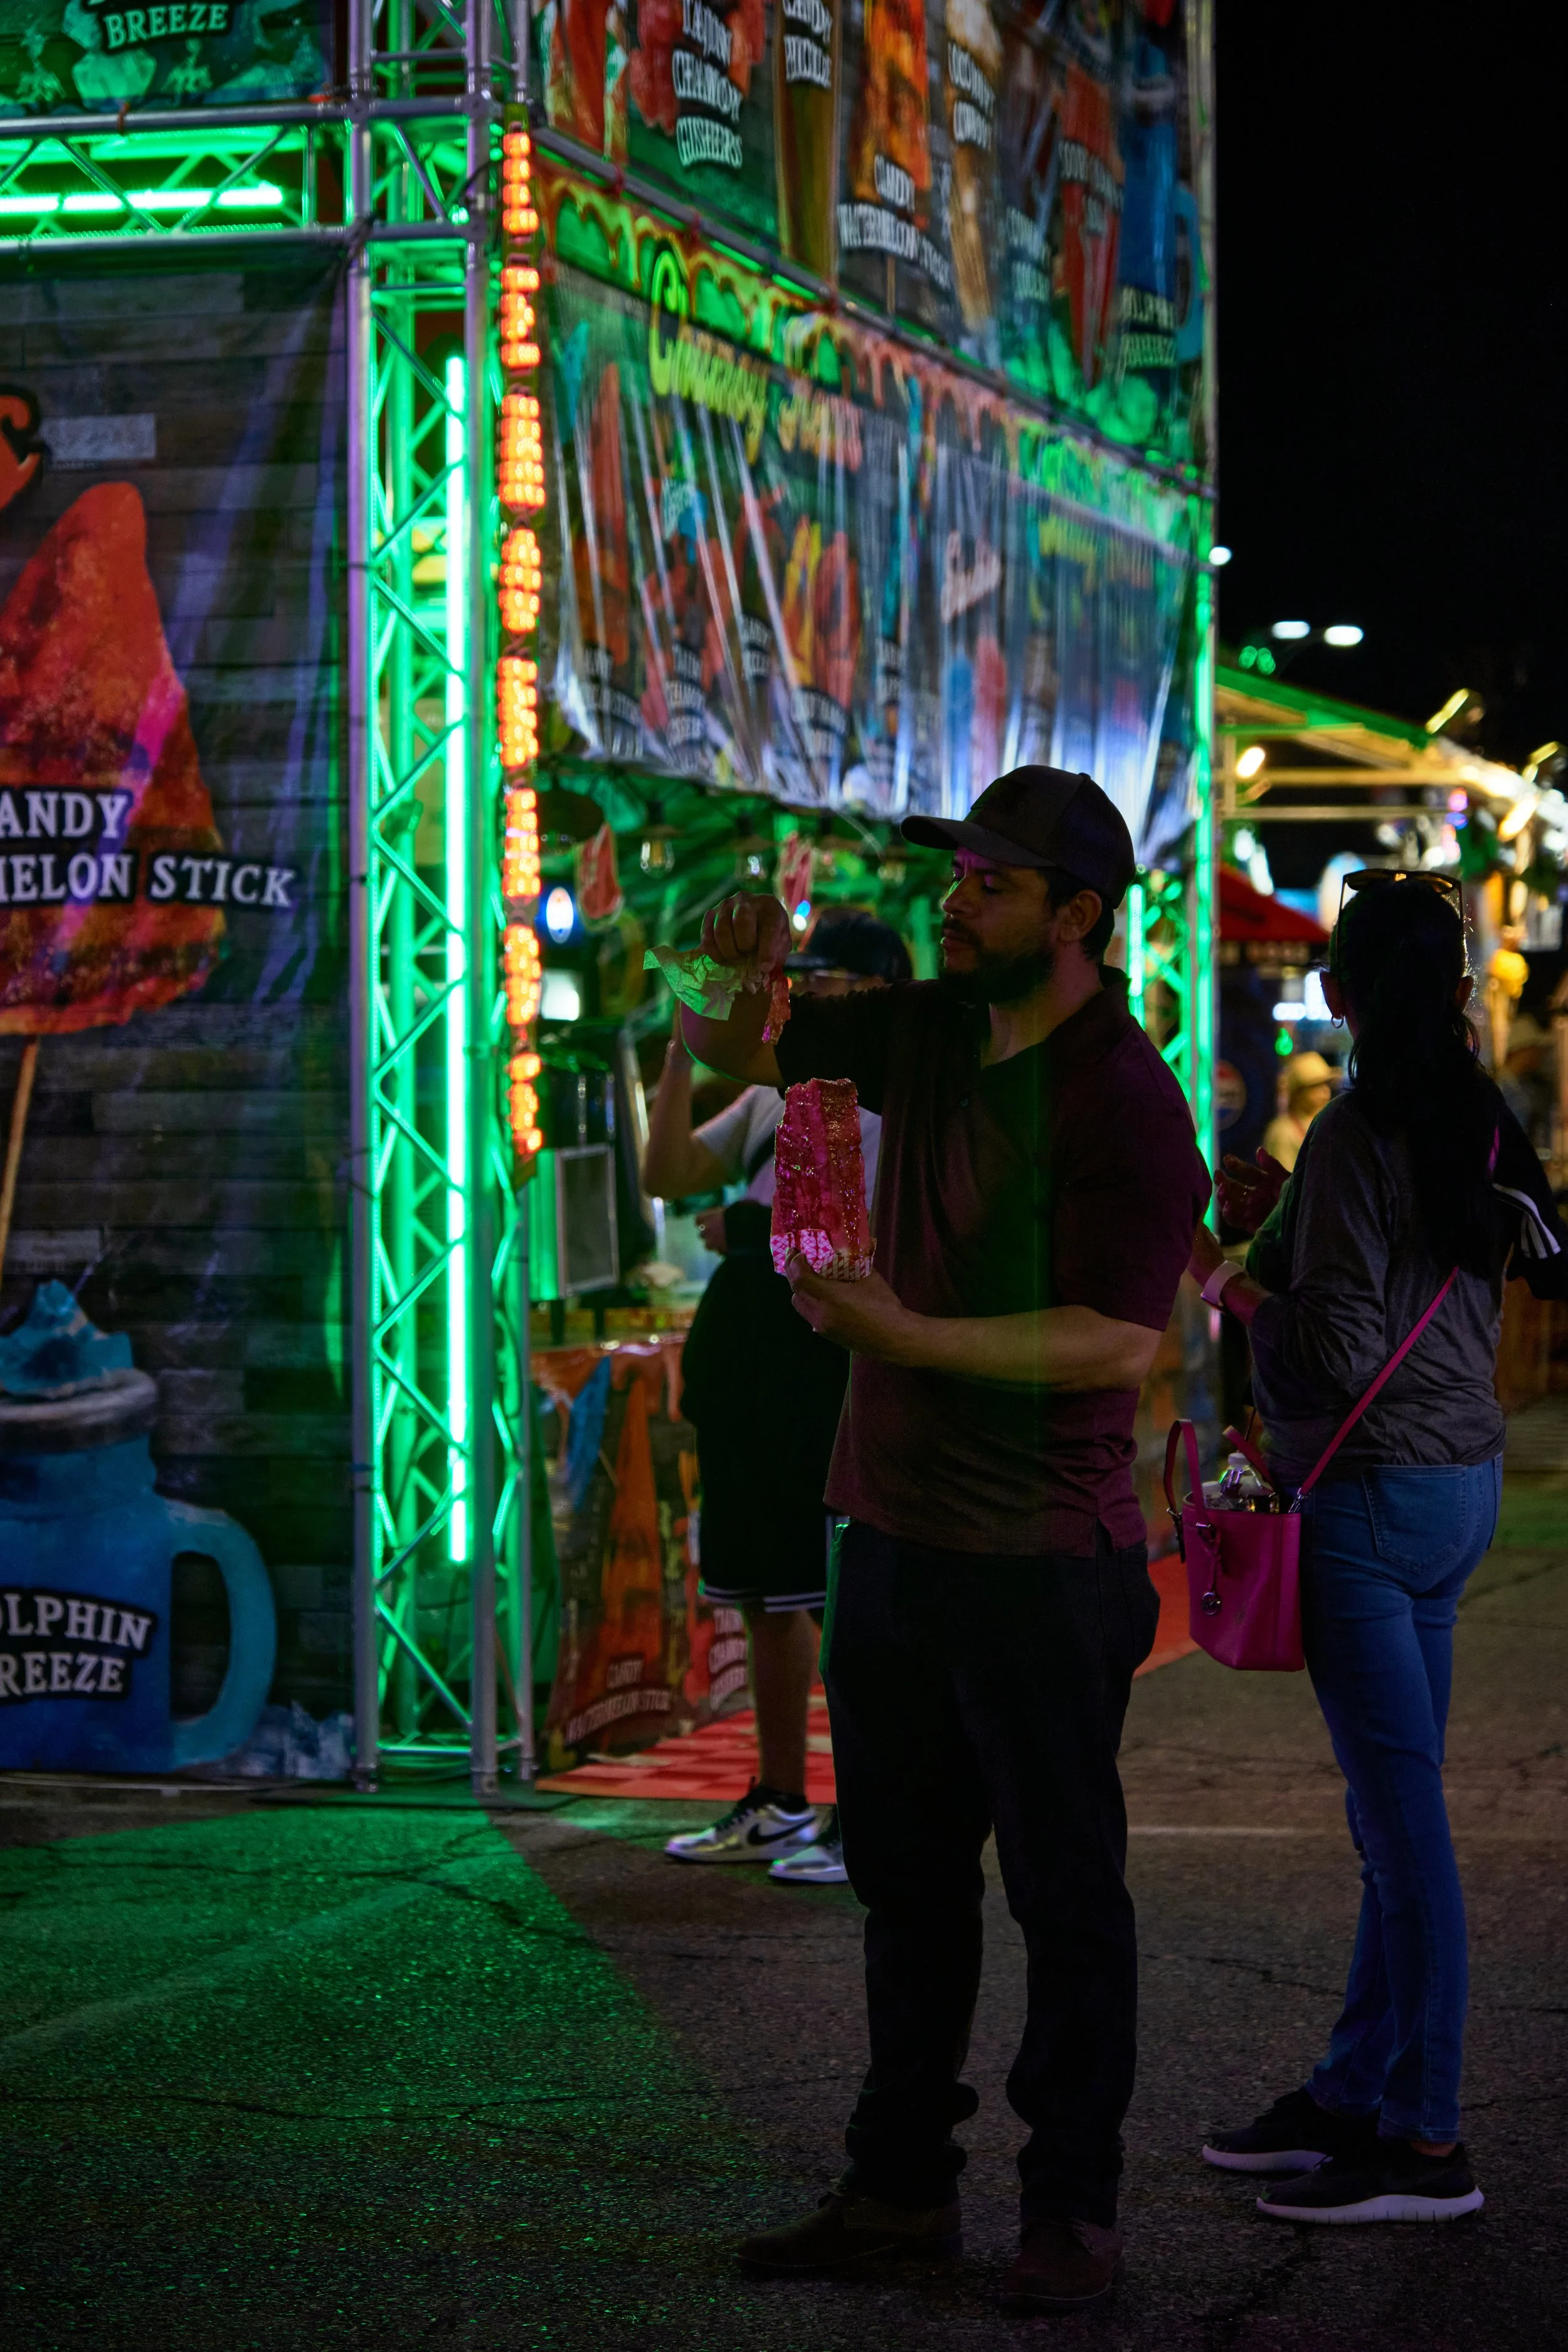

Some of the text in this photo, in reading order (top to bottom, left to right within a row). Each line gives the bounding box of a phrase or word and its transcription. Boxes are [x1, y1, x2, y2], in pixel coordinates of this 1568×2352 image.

[102, 1, 230, 50] BREEZE
[672, 48, 743, 124] CHAMOY
[676, 115, 743, 169] GUSHERS
[874, 153, 916, 213] CANDY
[836, 203, 919, 261] WATERMELON
[150, 854, 296, 908] STICK
[0, 1592, 152, 1651] LPHIN
